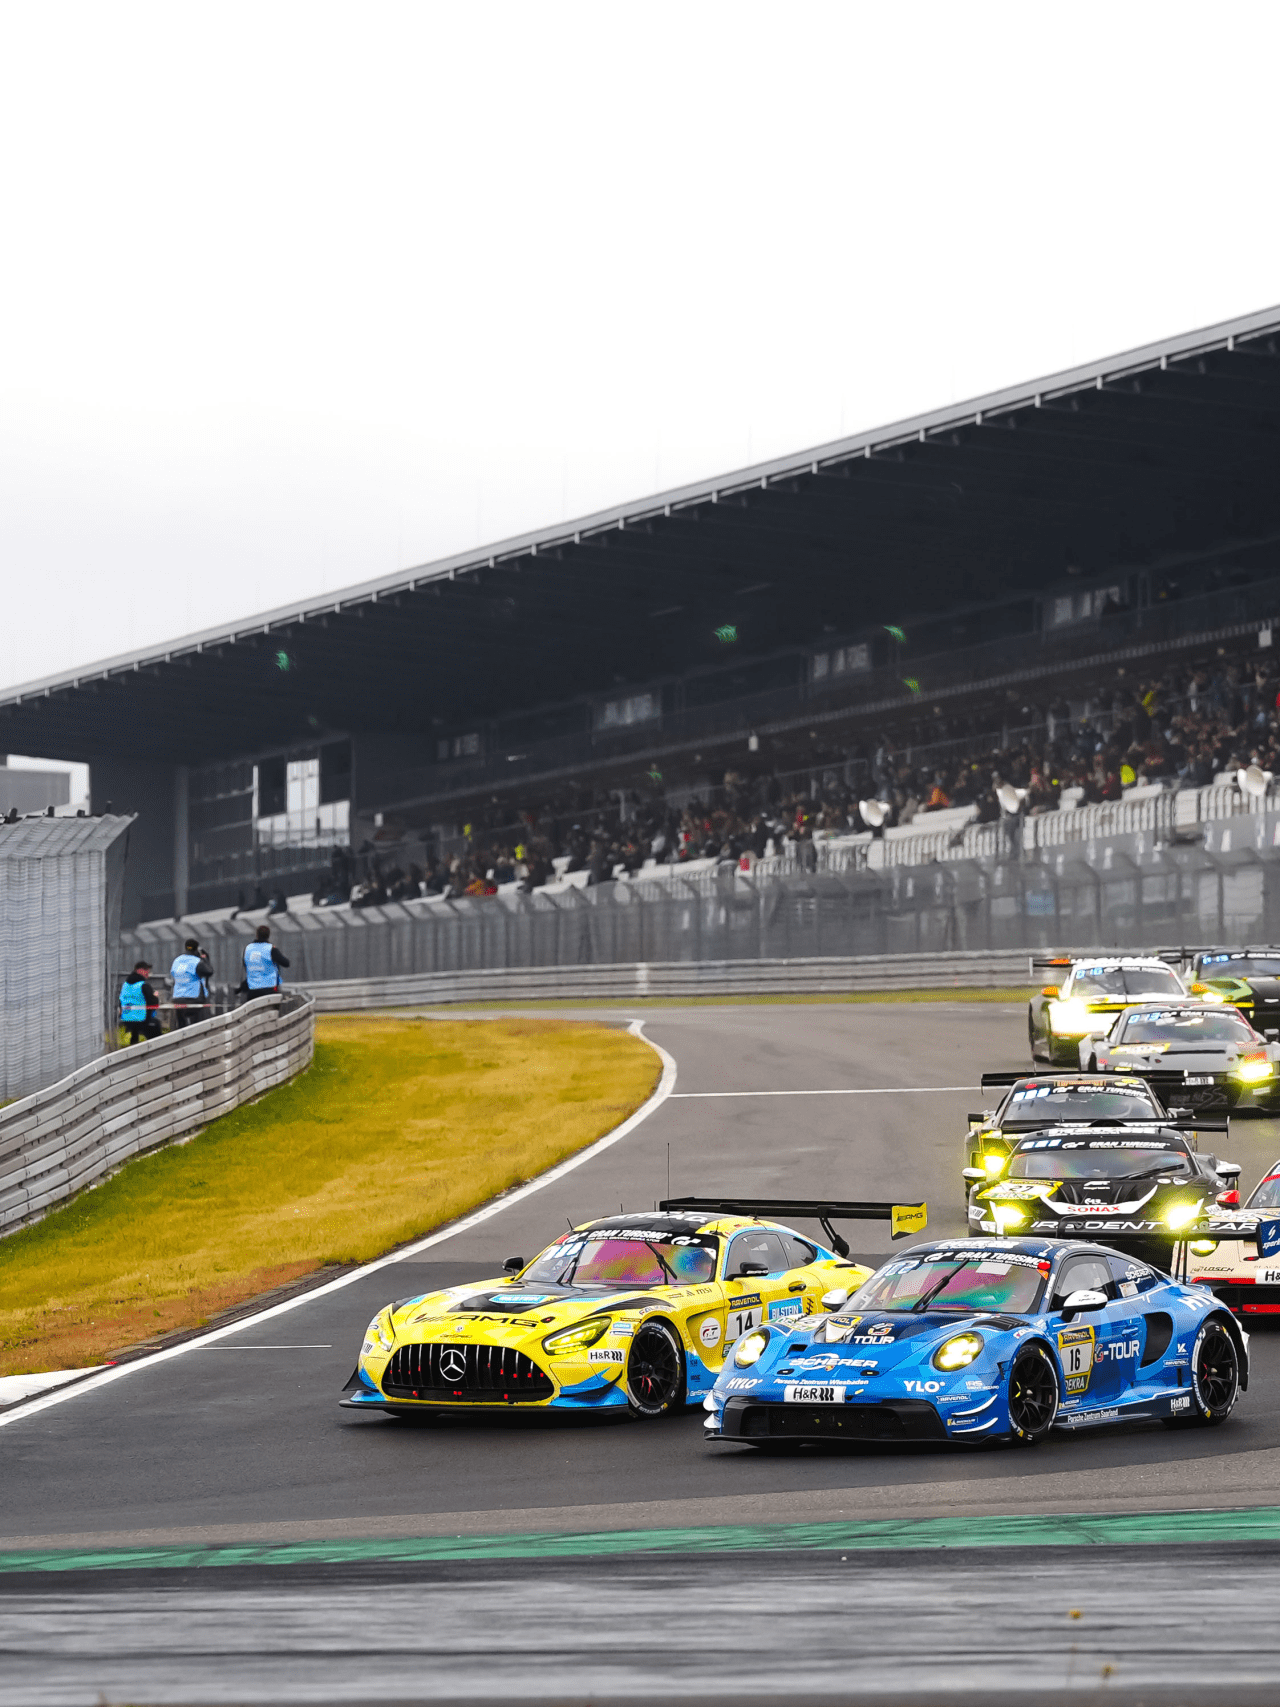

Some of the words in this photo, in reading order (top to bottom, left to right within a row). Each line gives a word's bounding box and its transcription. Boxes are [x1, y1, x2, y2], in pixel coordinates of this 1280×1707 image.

[1089, 1141, 1118, 1149] GRAN
[1119, 1141, 1167, 1150] TURISMO
[588, 1229, 620, 1240] GRAN
[618, 1230, 669, 1241] TURISMO
[1263, 1238, 1280, 1250] spark
[954, 1251, 992, 1261] GRAN
[696, 1287, 713, 1296] msi
[732, 1296, 760, 1307] RAVENOL
[771, 1304, 799, 1319] BILSTEIN
[450, 1314, 540, 1328] AMG
[736, 1311, 754, 1337] 14
[853, 1335, 895, 1345] TOUR
[789, 1357, 879, 1369] SCHERER
[1070, 1348, 1081, 1372] 16
[1065, 1376, 1086, 1392] DEKRA
